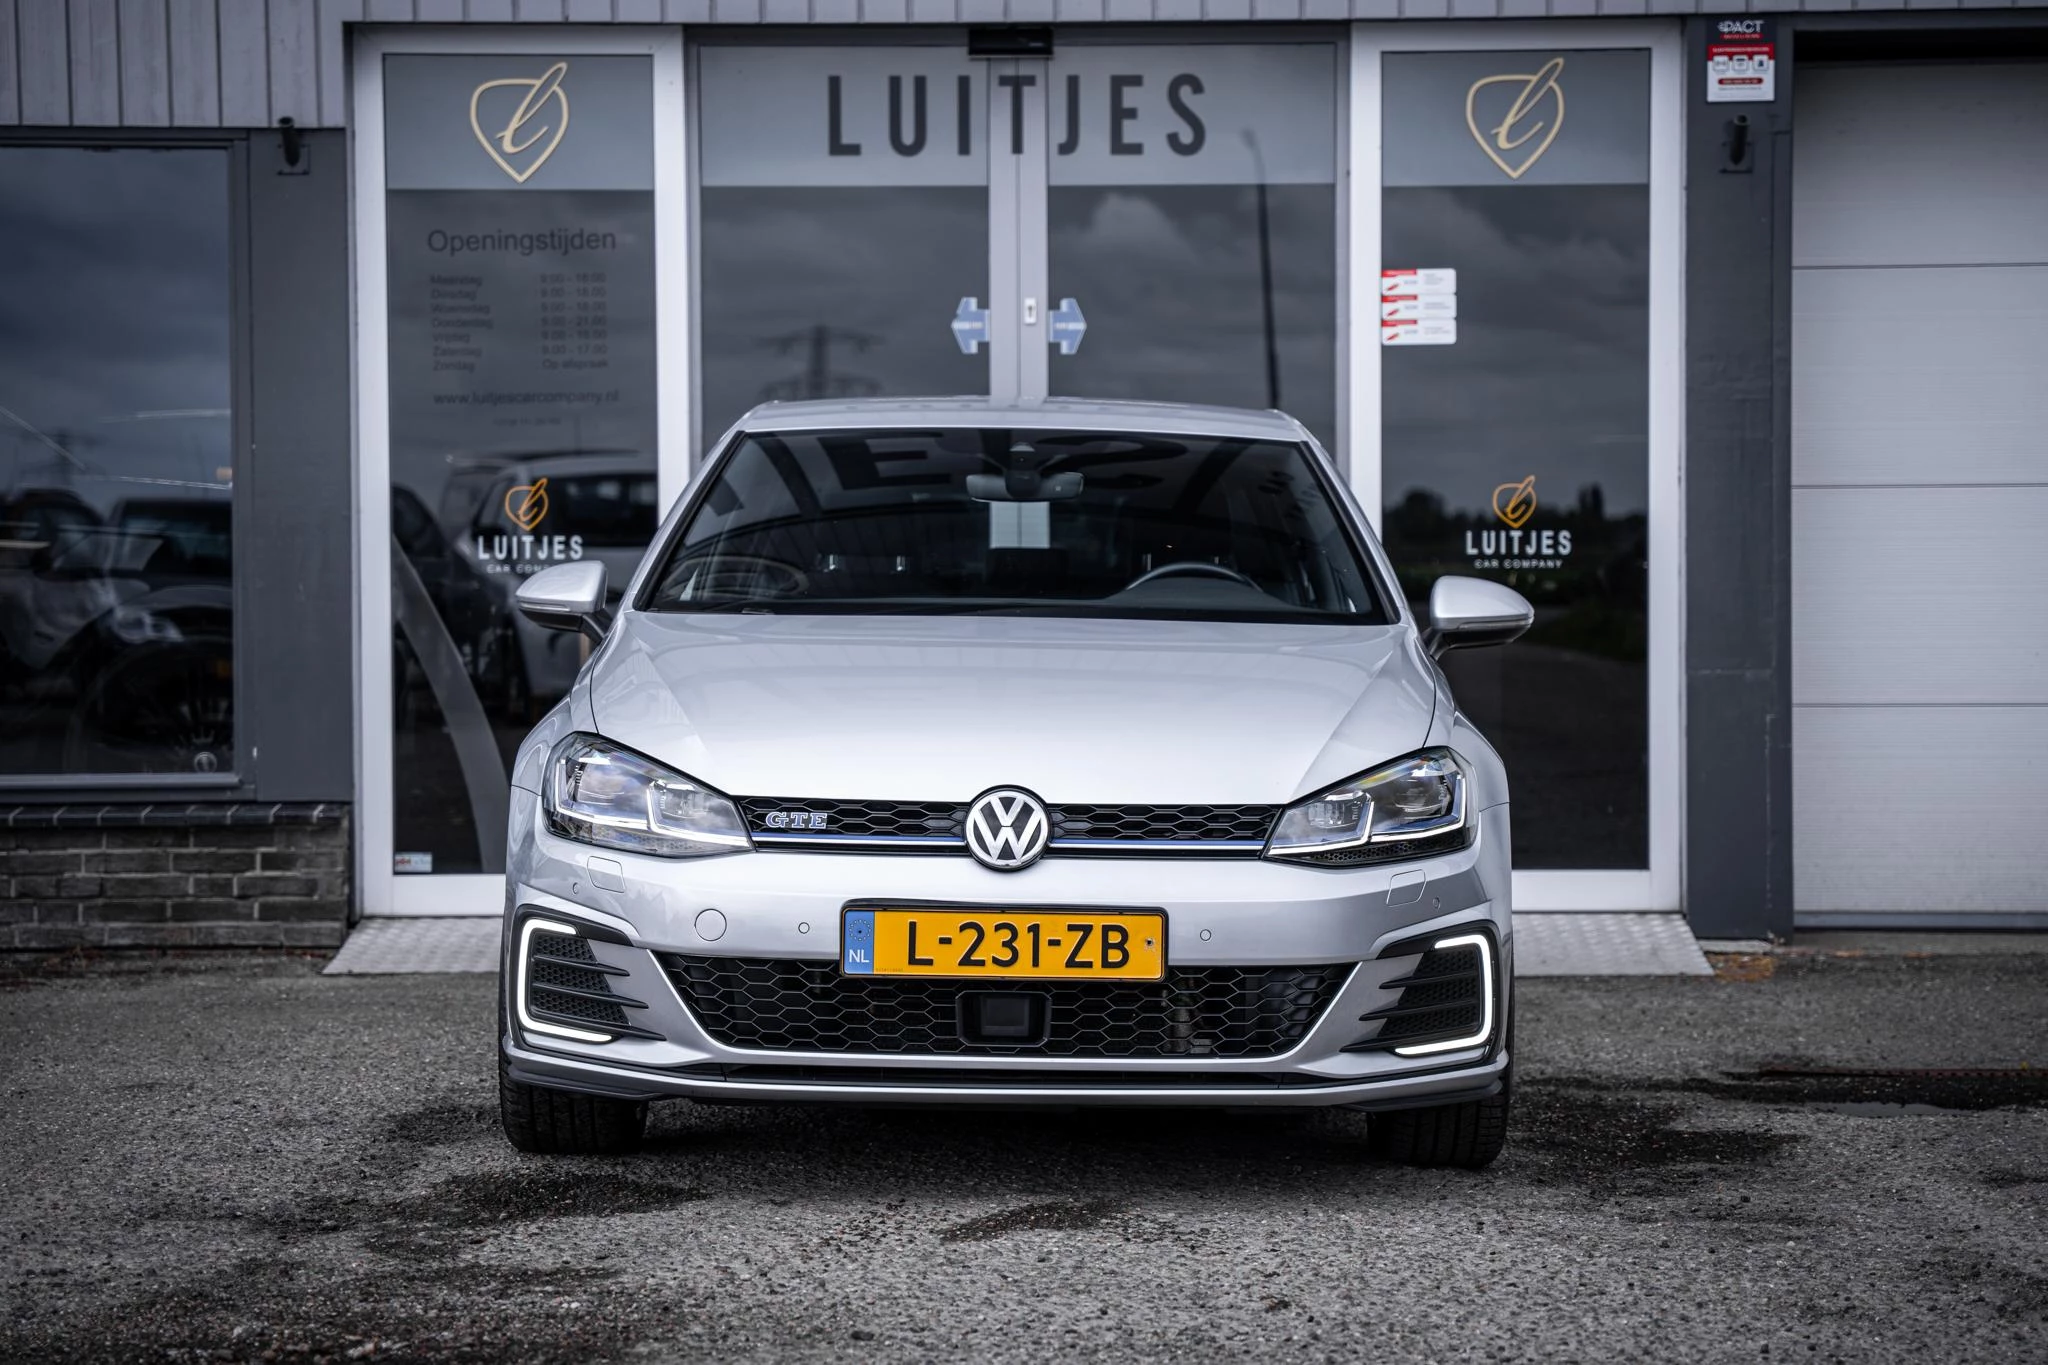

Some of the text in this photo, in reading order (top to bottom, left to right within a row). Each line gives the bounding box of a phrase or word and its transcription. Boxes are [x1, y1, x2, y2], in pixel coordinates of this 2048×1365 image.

[828, 73, 1206, 156] LUITJES
[427, 228, 616, 256] Openingstijden
[478, 535, 583, 560] LUITJES
[1466, 530, 1572, 555] LUITJES
[486, 564, 510, 574] CAR
[1474, 559, 1563, 569] CAR COMPANY
[765, 811, 828, 830] GTE
[848, 949, 870, 963] NL
[907, 920, 1130, 969] L-231-ZB
